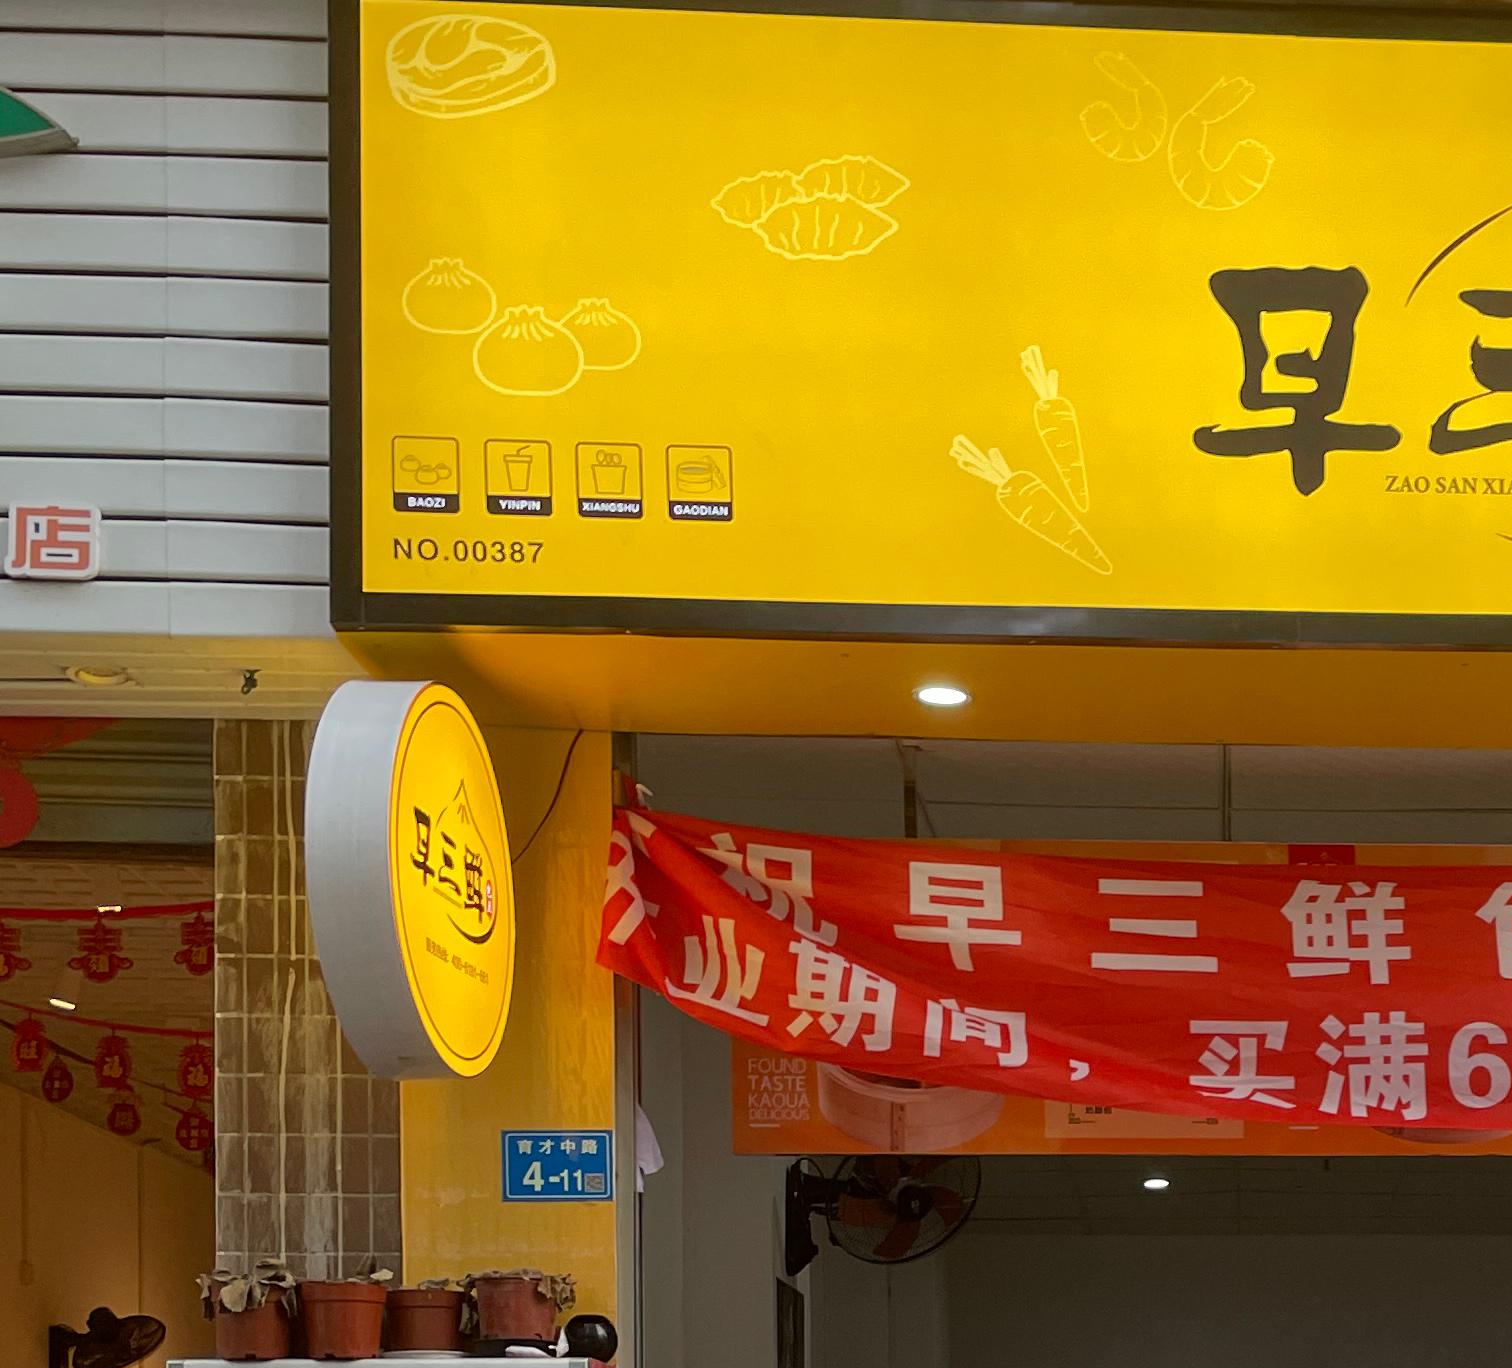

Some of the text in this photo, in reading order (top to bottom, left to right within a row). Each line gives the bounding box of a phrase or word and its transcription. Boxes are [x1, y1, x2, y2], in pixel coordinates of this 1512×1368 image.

[1384, 475, 1431, 493] ZAO
[1435, 477, 1478, 494] SAN
[407, 497, 446, 509] BAOZI
[499, 499, 541, 512] YINPIN
[581, 502, 640, 514] XIANGSHU
[673, 504, 729, 517] GAODIAN
[11, 506, 91, 570] 店
[393, 538, 544, 564] NO.00387
[748, 1057, 806, 1074] FOUND
[748, 1075, 806, 1092] TASTE
[522, 1161, 582, 1192] 4-11
